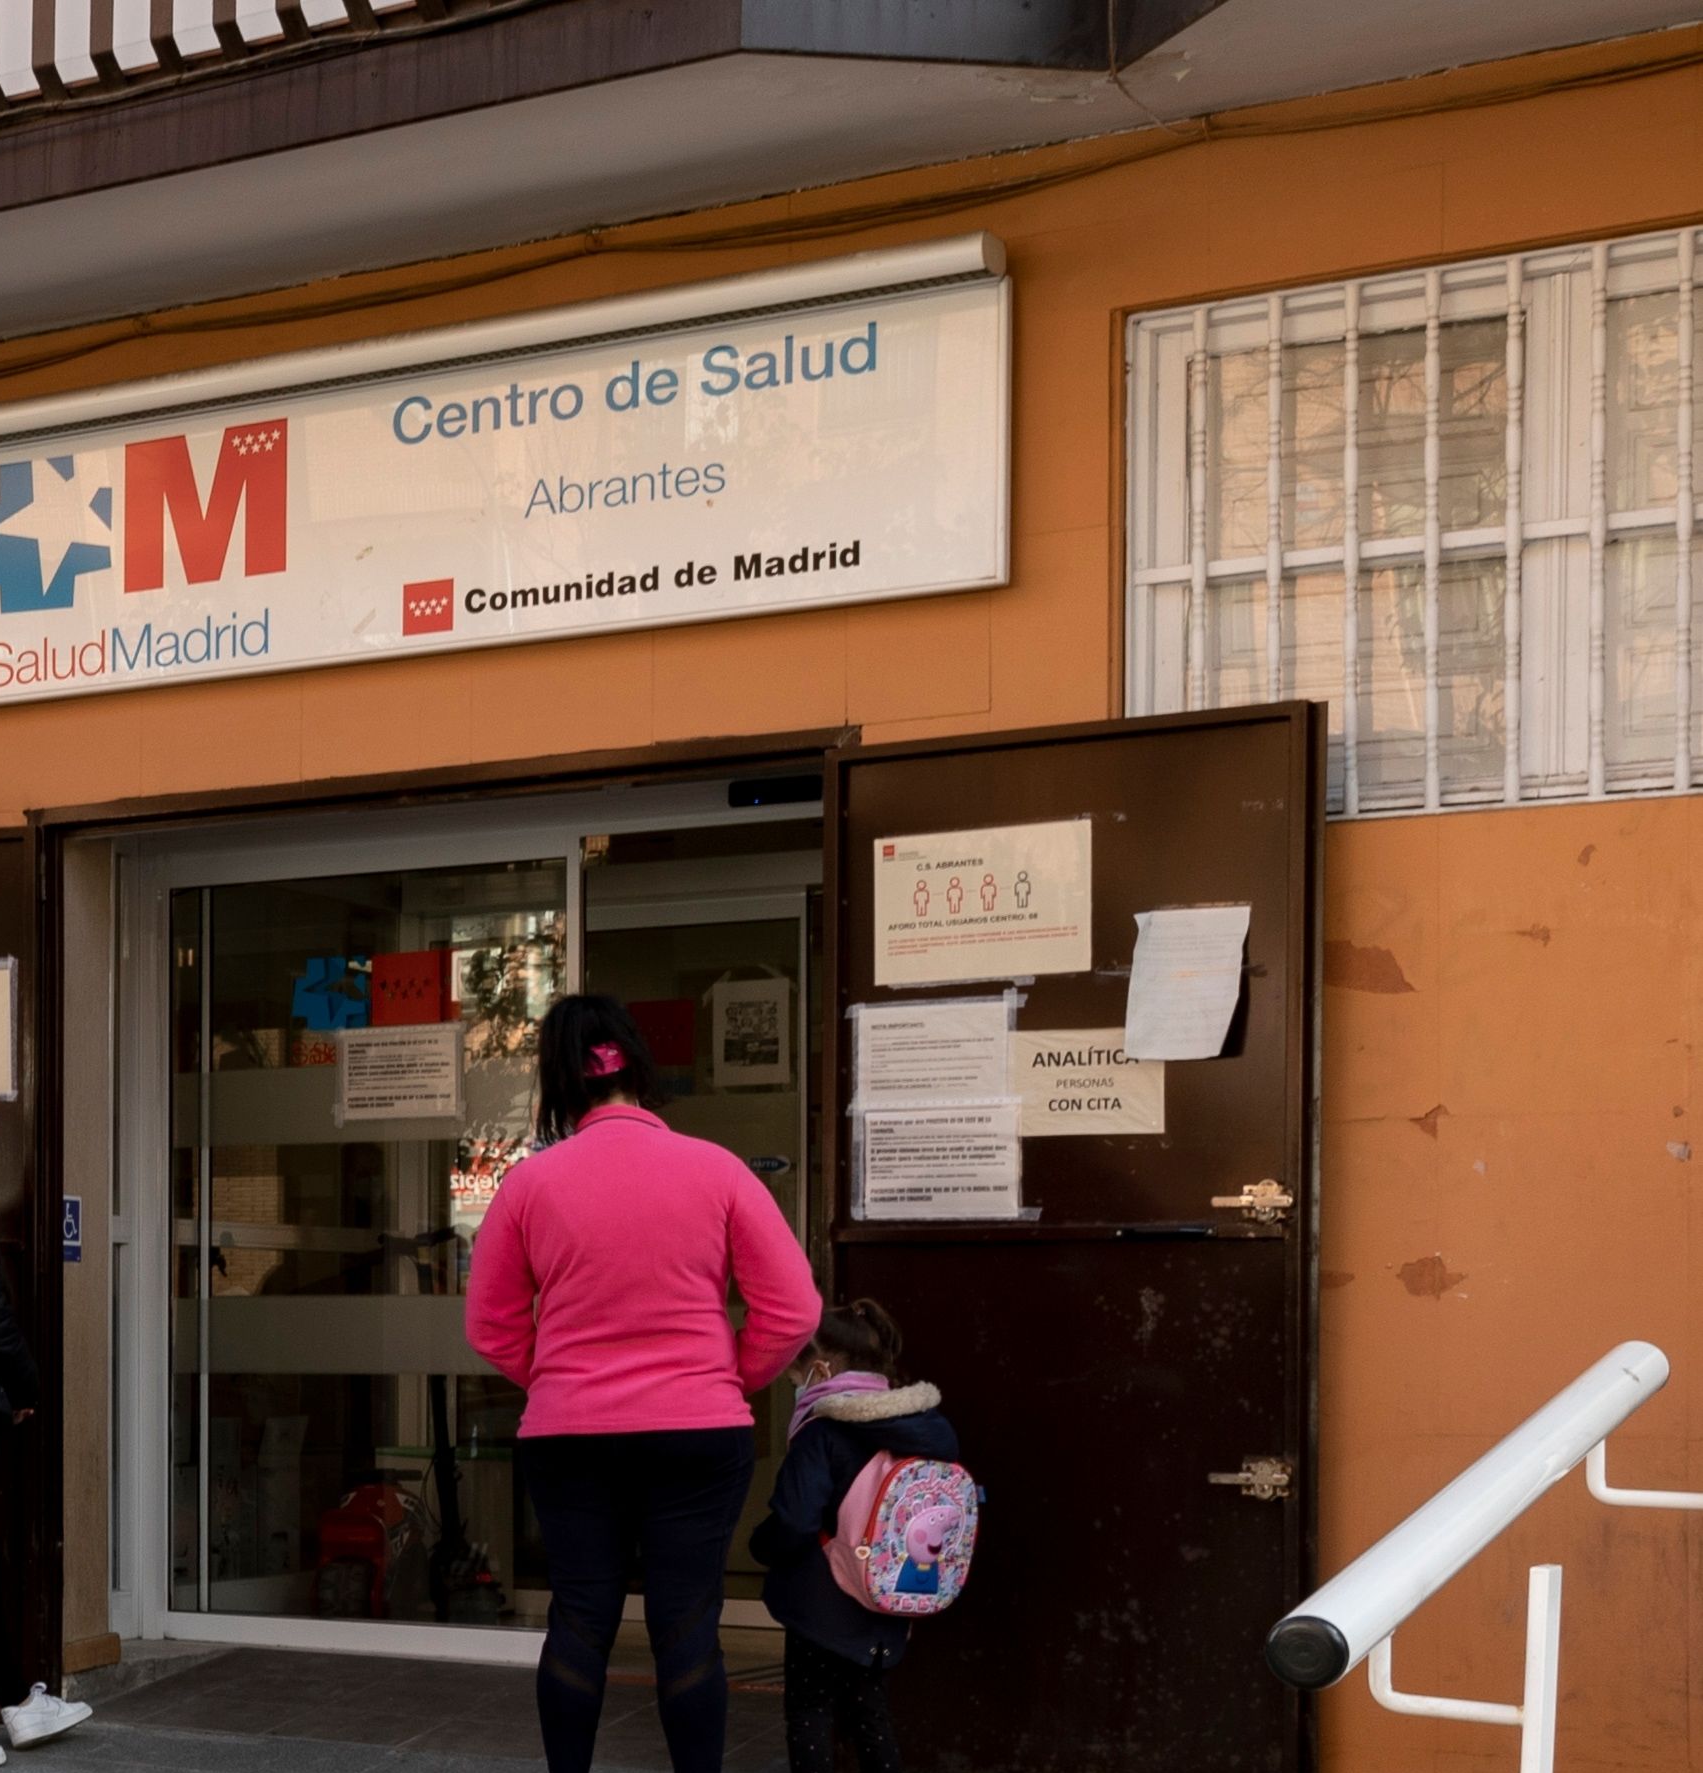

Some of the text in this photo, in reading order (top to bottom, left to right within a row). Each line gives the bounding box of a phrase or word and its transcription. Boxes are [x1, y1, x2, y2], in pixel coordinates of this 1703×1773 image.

[392, 321, 879, 446] Centro de Salud
[124, 418, 288, 593] M
[524, 460, 727, 519] Abrantes
[464, 540, 862, 616] Comunidad de Madrid
[935, 858, 984, 870] ABRANTES
[888, 921, 917, 931] AFORO
[918, 919, 944, 929] TOTAL
[1055, 1078, 1115, 1089] PERSONAS
[1048, 1097, 1123, 1112] CON CITA
